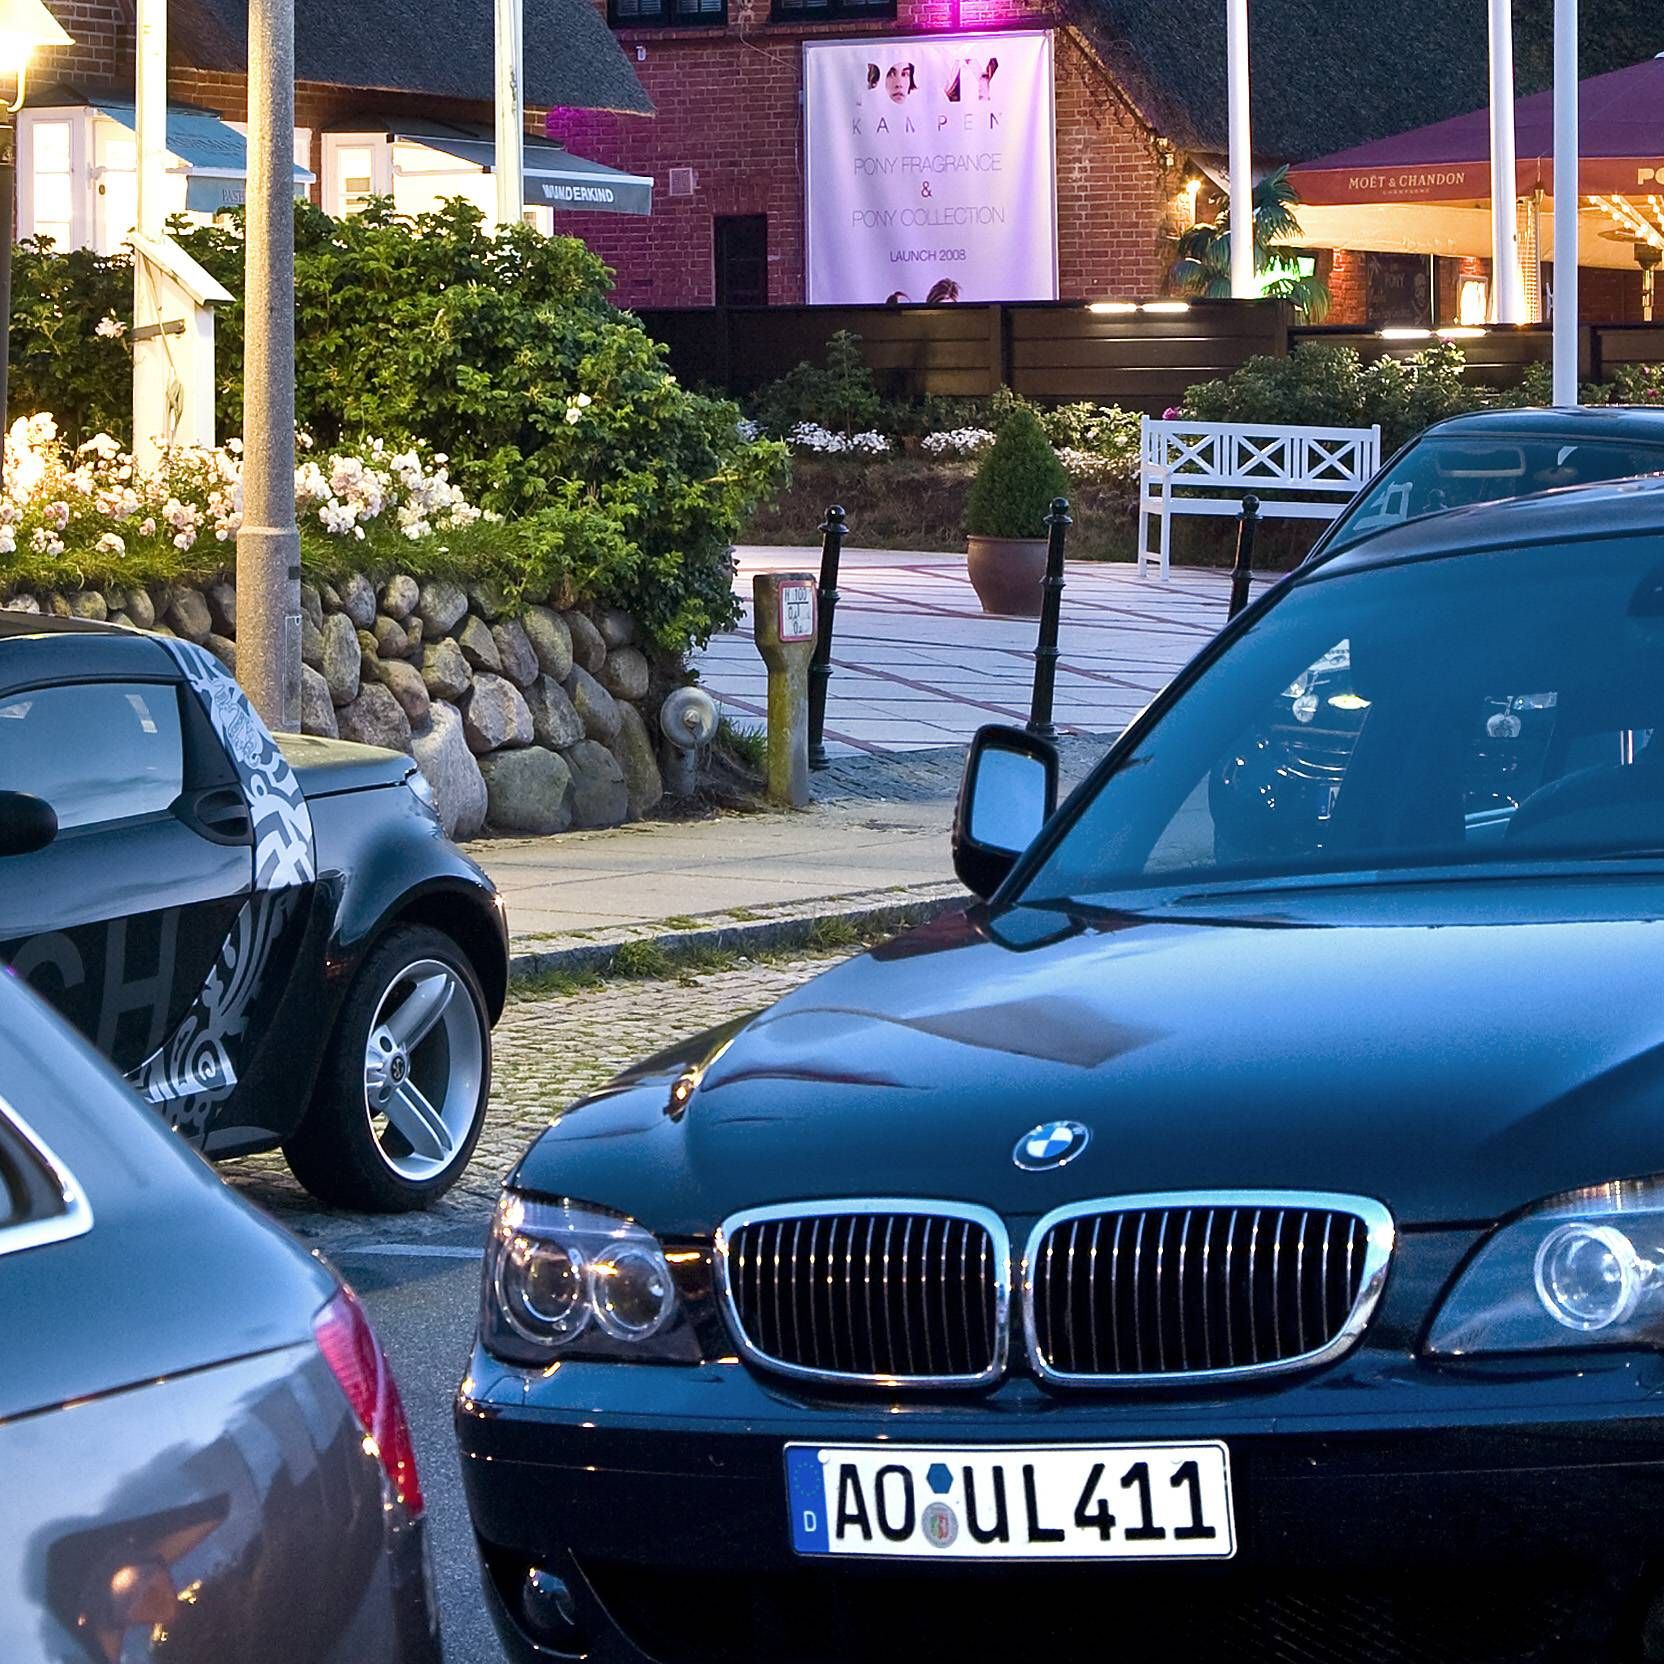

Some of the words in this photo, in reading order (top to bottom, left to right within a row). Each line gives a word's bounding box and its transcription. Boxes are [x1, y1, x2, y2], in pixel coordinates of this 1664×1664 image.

[854, 156, 898, 176] PONY
[901, 152, 1003, 174] FRAGRANCE
[1388, 177, 1397, 187] &
[1399, 172, 1465, 187] CHANDON
[542, 184, 615, 203] WUNDERKIND
[921, 181, 933, 198] &
[852, 210, 897, 228] PONY
[900, 206, 1005, 227] COLLECTION
[890, 249, 936, 263] LAUNCH
[803, 1510, 816, 1533] D
